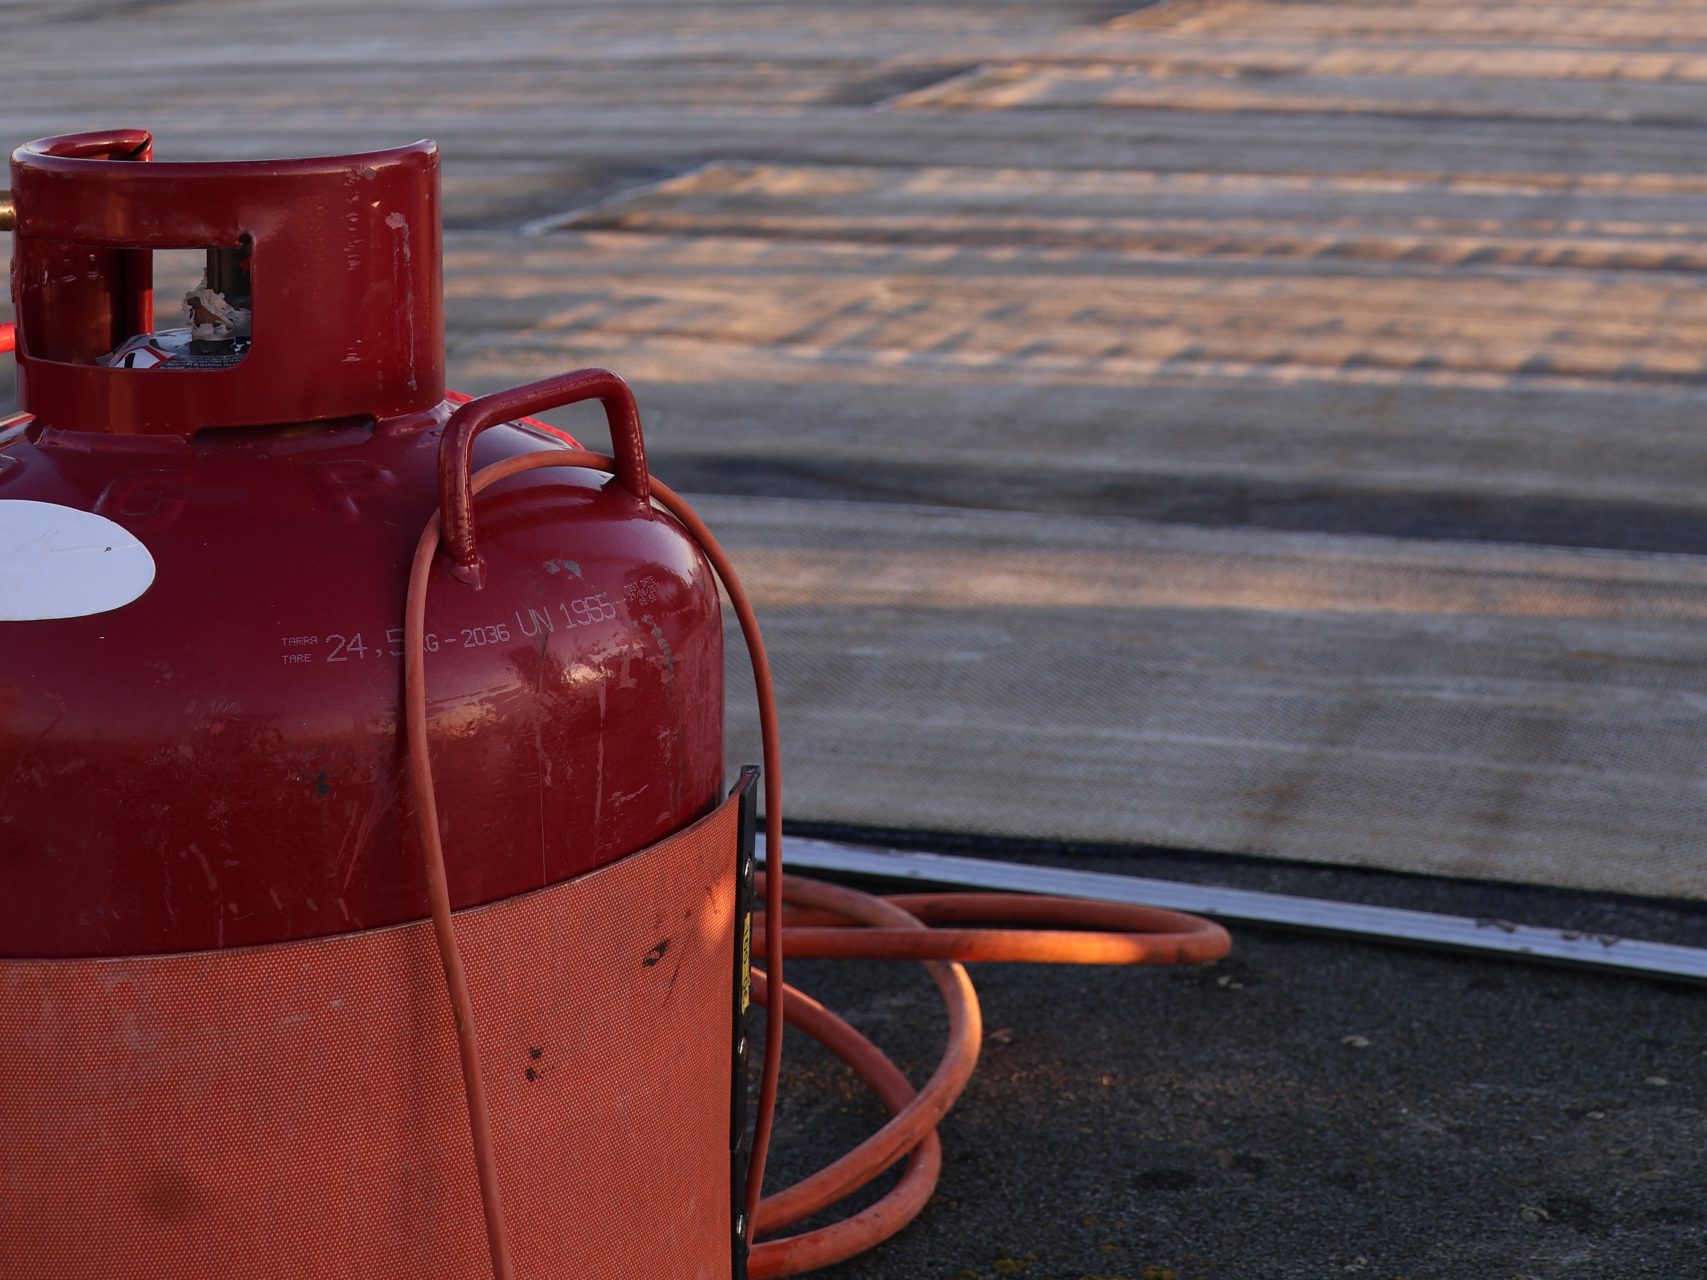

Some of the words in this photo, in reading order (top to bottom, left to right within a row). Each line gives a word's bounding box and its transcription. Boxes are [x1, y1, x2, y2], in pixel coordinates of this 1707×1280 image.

[460, 623, 511, 649] 2036
[515, 606, 555, 638] UN
[559, 592, 617, 629] 1965
[281, 636, 318, 646] TARRA
[281, 653, 312, 664] TARE
